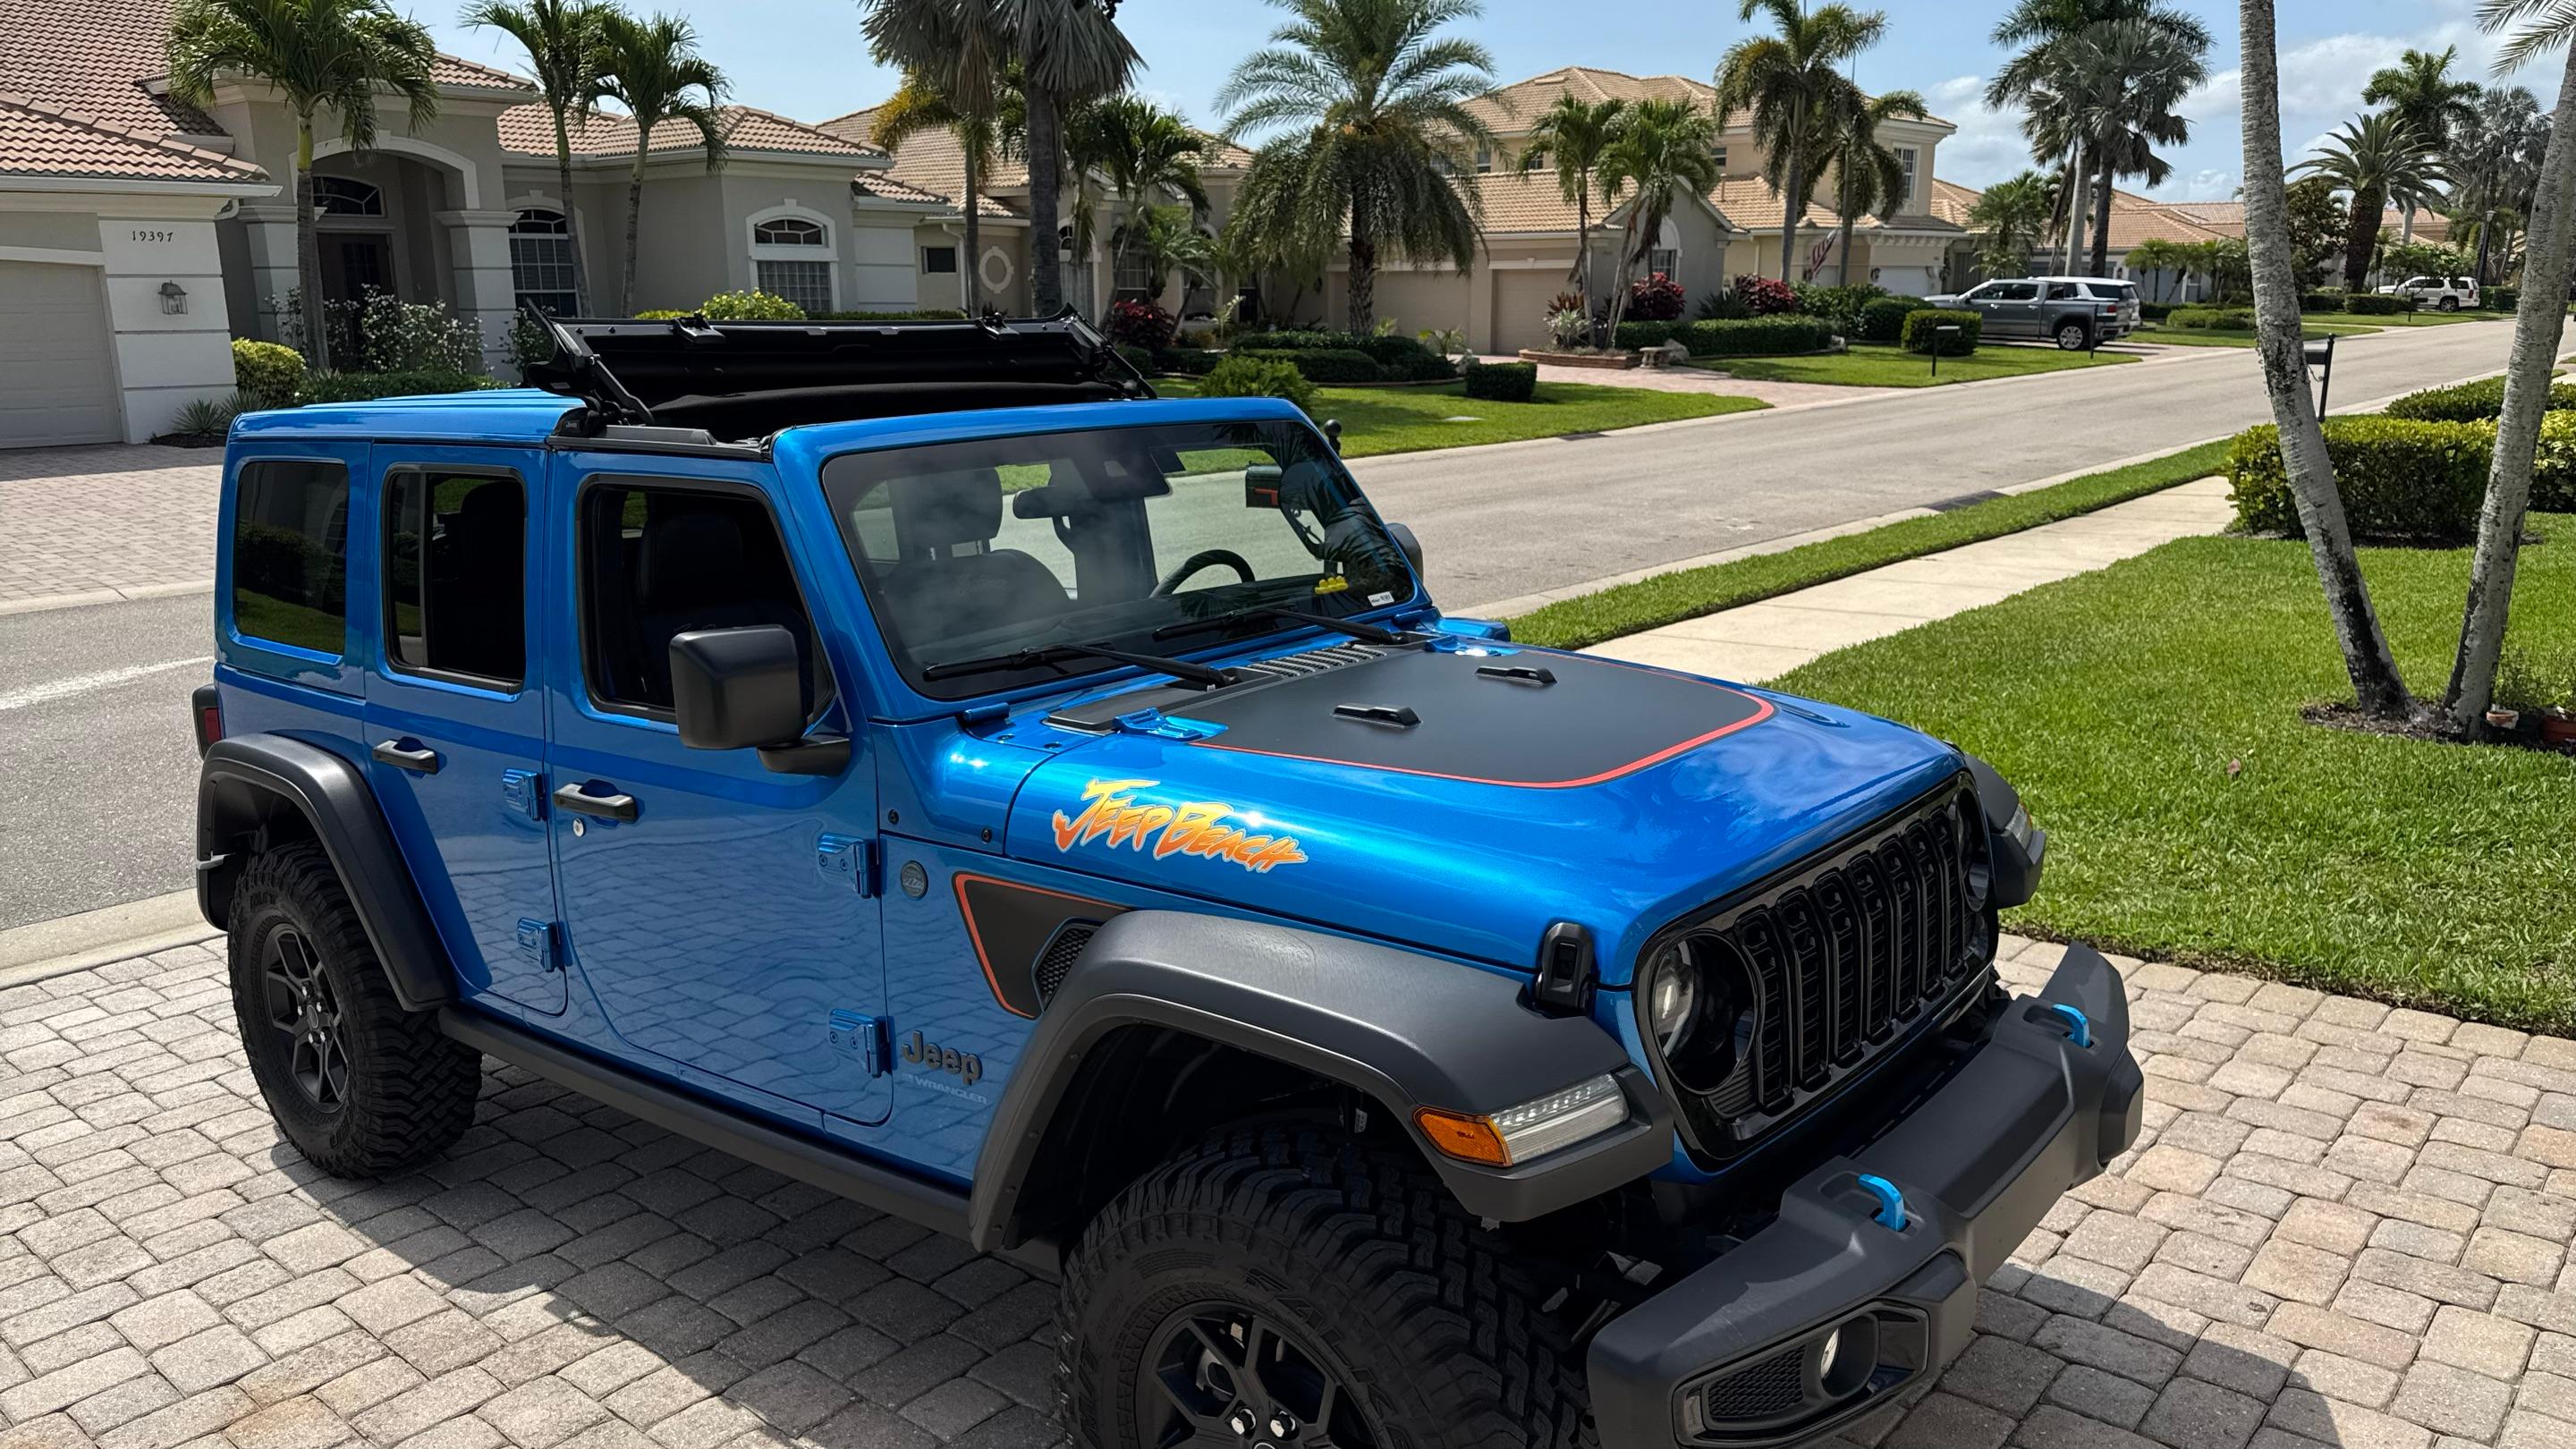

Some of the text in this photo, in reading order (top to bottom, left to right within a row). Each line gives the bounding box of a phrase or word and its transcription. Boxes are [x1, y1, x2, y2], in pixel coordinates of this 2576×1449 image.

[132, 230, 174, 242] 19397
[902, 1030, 983, 1086] Jeep
[914, 1075, 988, 1106] WRANGLER
